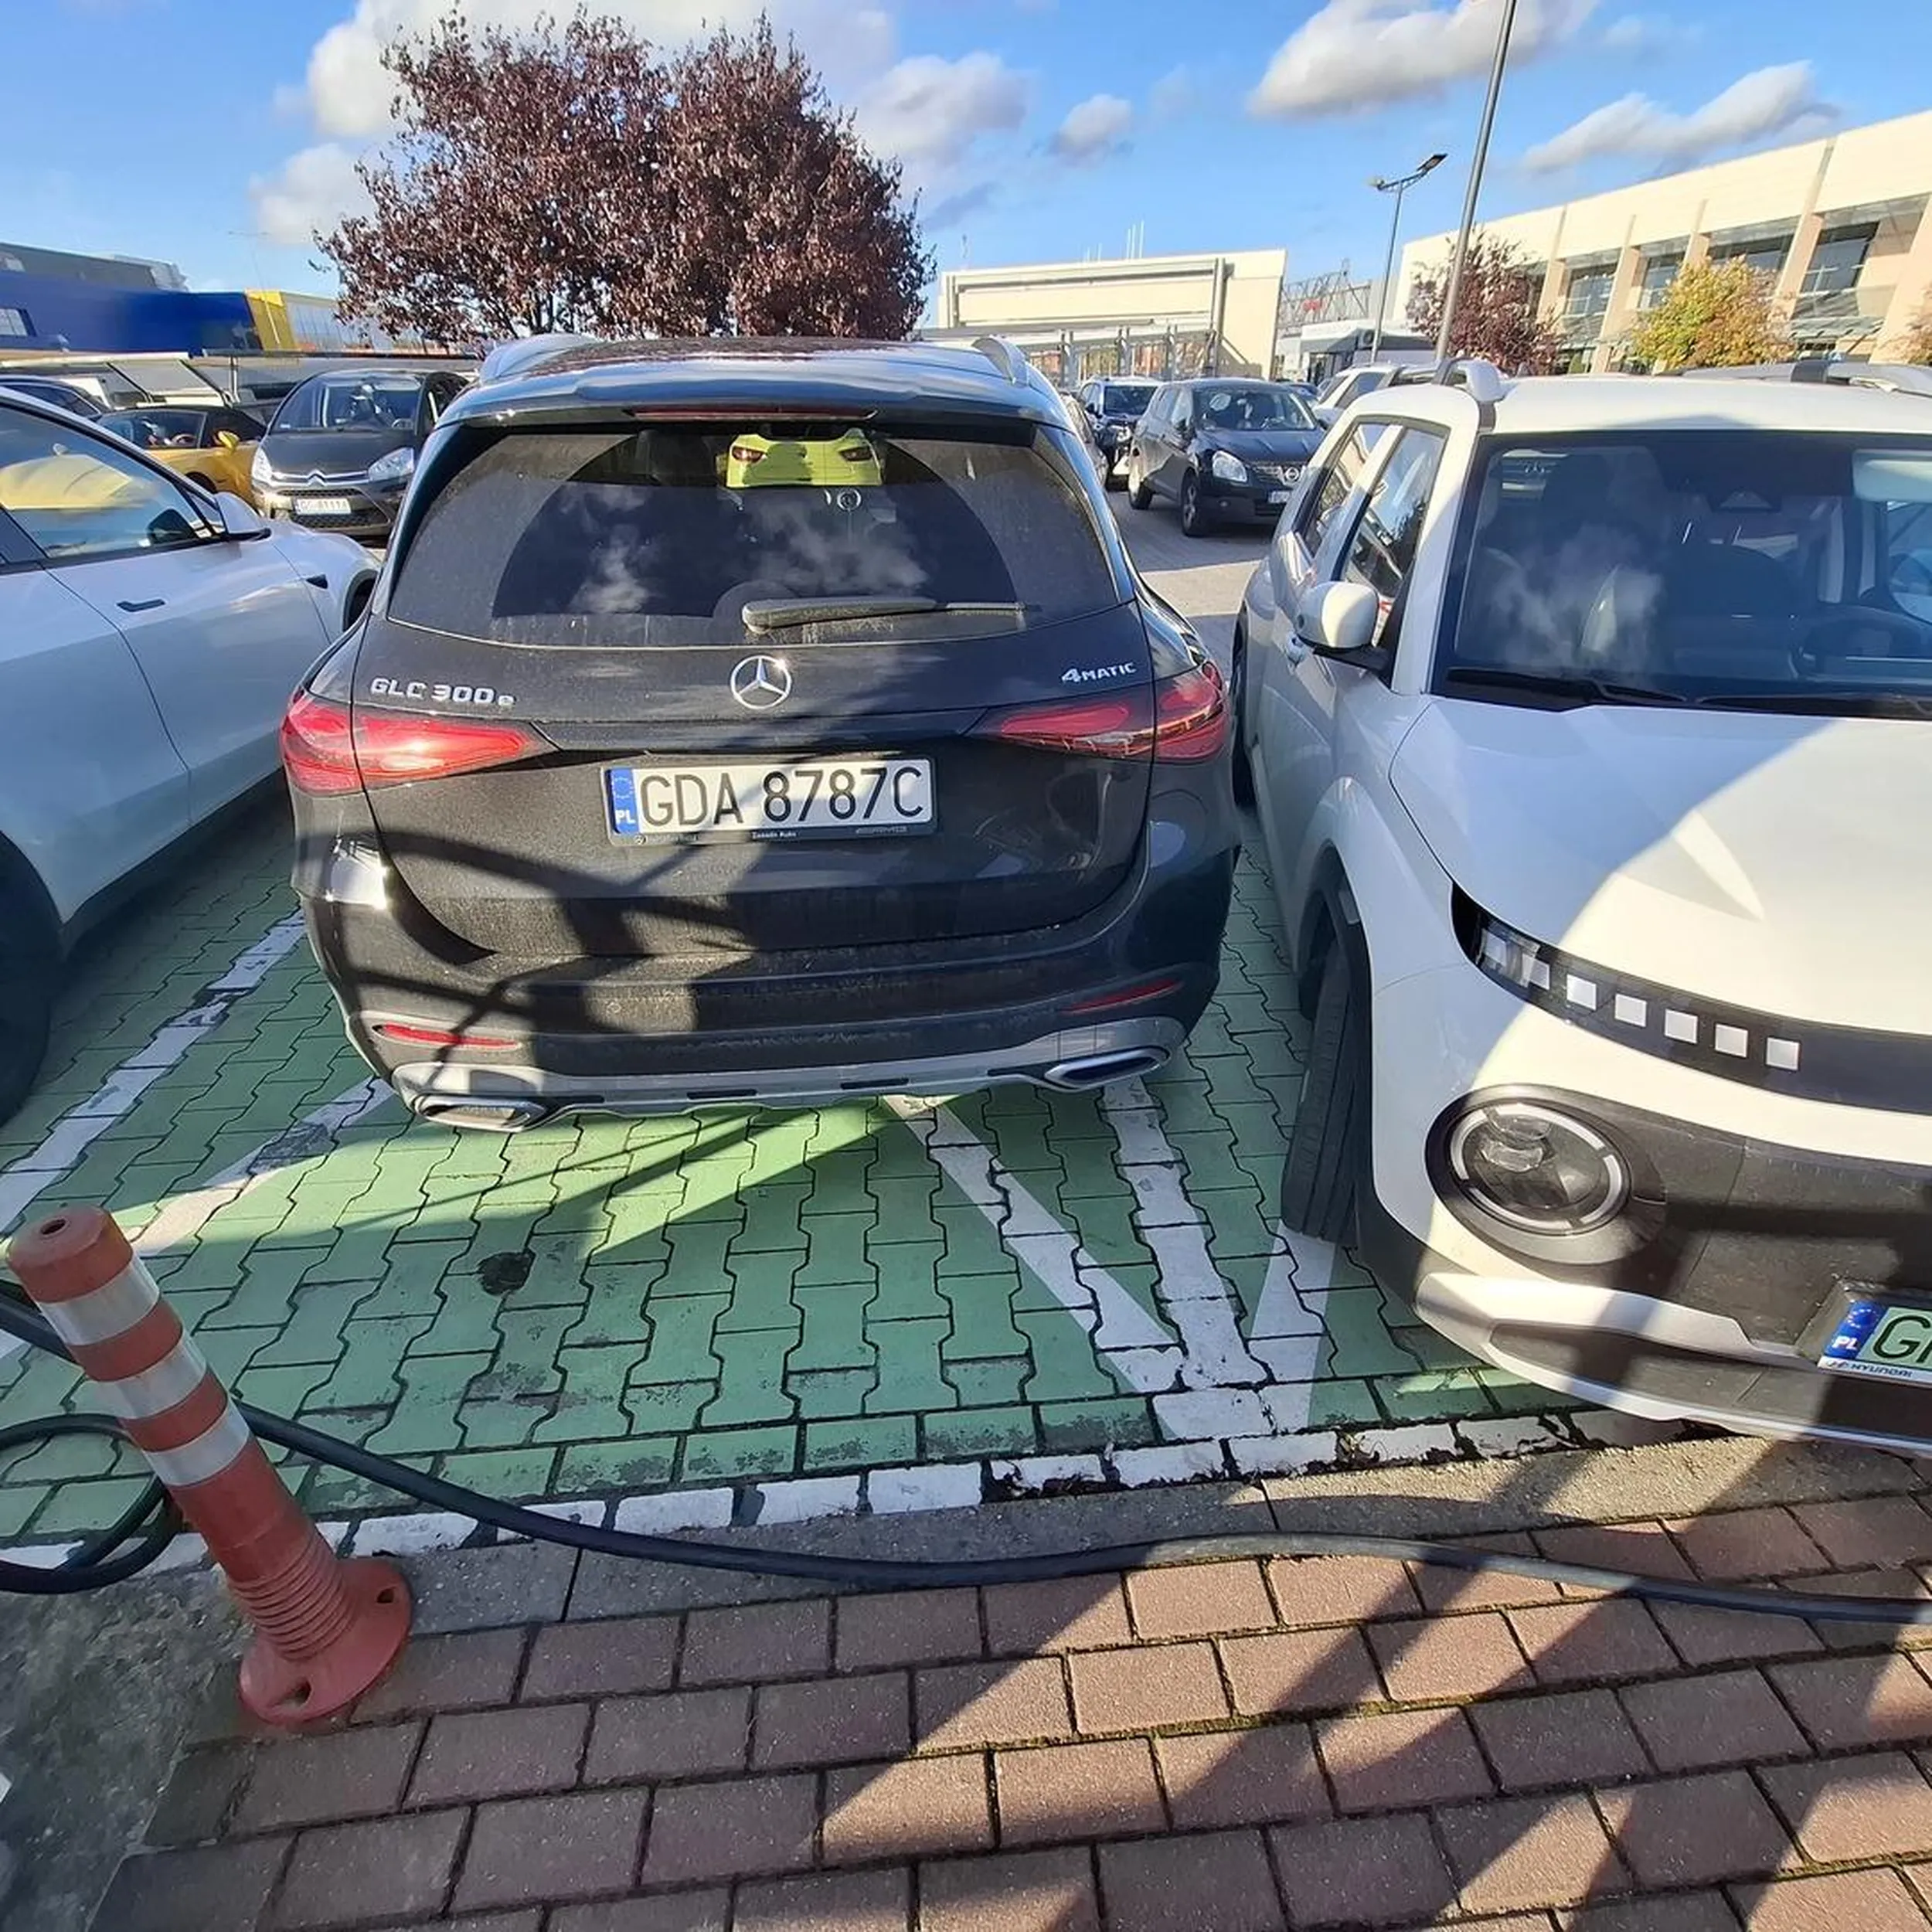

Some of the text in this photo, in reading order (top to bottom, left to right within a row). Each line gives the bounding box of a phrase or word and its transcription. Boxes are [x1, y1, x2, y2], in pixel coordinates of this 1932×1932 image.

[1061, 662, 1137, 682] 4MATIC
[370, 677, 428, 700] GLC
[640, 766, 923, 827] GDA 8787C
[614, 810, 636, 825] PL
[1831, 1335, 1858, 1351] PL
[1872, 1315, 1932, 1363] G
[1850, 1362, 1913, 1378] HYUNDAI
